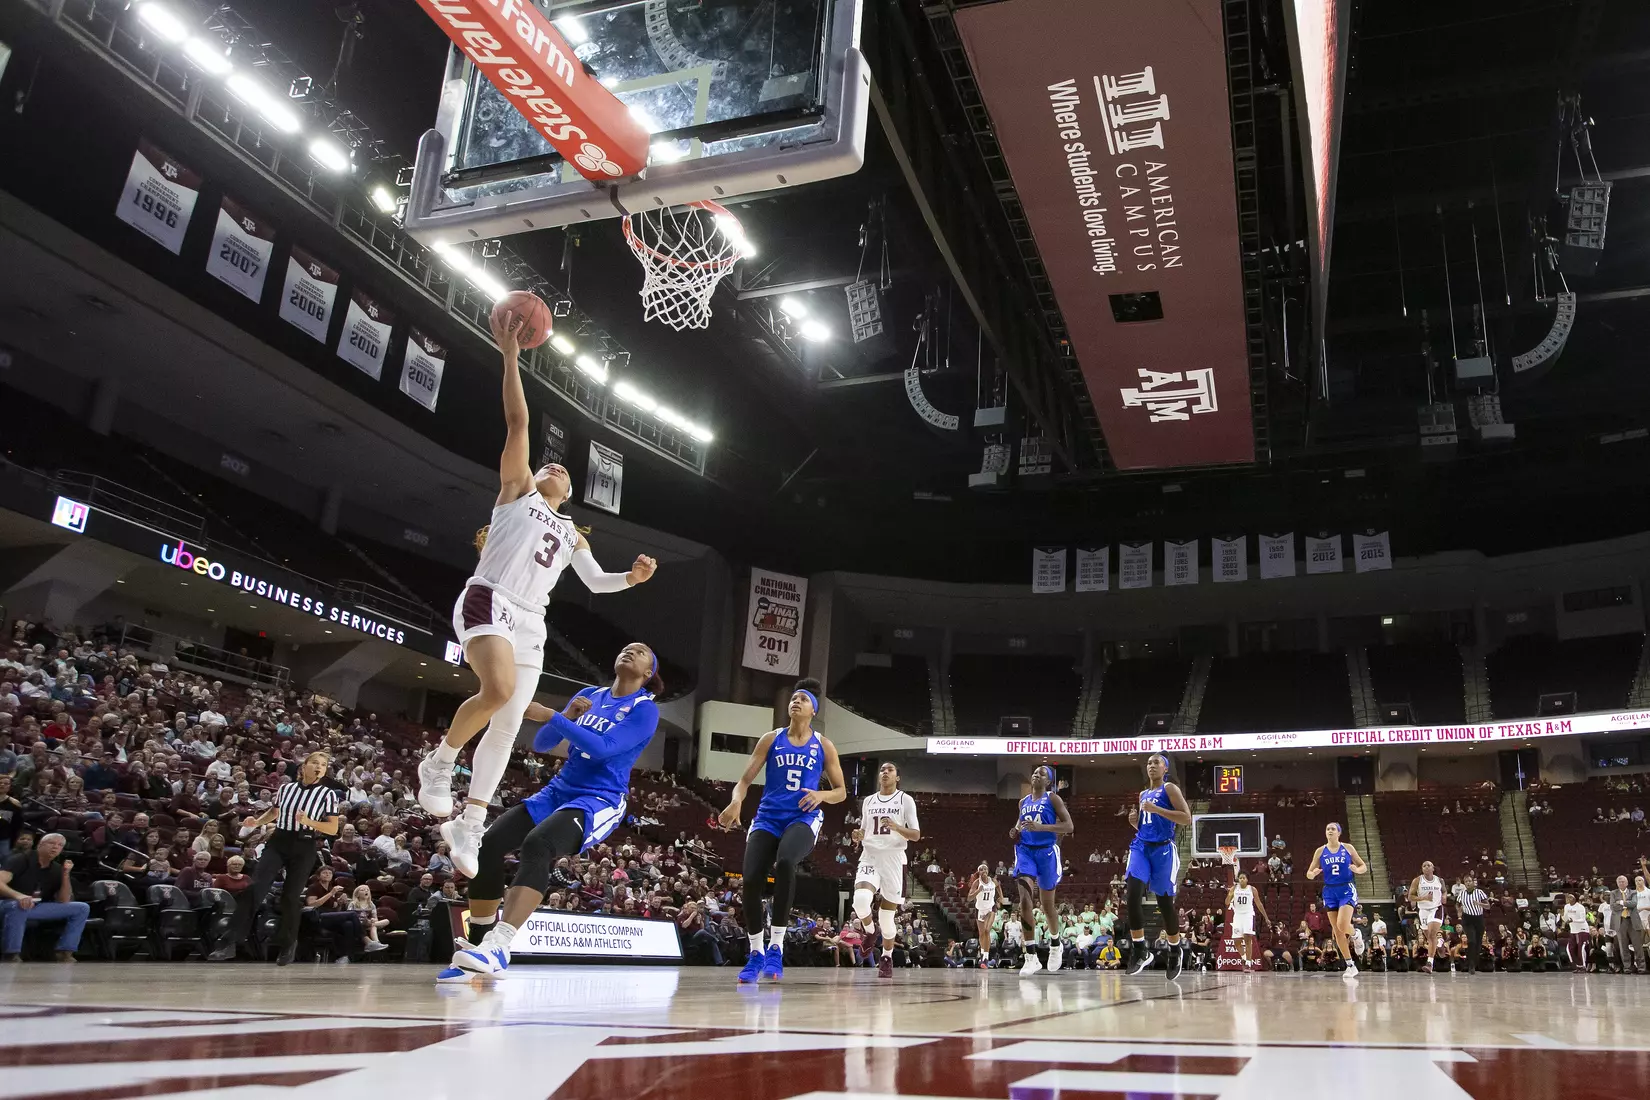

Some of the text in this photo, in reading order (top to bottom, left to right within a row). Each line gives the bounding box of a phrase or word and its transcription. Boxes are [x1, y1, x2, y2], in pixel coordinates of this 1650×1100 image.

[1047, 78, 1081, 140] Where
[1063, 142, 1102, 207] students
[140, 182, 182, 211] CHAMPIONSHIP
[133, 188, 179, 228] 1996
[1144, 160, 1183, 269] AMERICAN
[1082, 208, 1108, 237] love
[1115, 163, 1157, 272] CAMPUS
[220, 244, 260, 278] 2007
[290, 289, 326, 322] 2008
[350, 330, 379, 359] 2010
[408, 366, 435, 393] 2013
[549, 423, 564, 440] 2013
[544, 446, 564, 463] GARY
[528, 506, 562, 536] TEXAS
[534, 532, 561, 569] 3
[1312, 551, 1336, 561] 2012
[1360, 549, 1385, 560] 2015
[160, 541, 405, 645] ubeo BUSINESS SERVICES
[754, 585, 801, 602] CHAMPIONS
[760, 577, 797, 593] NATIONAL
[758, 635, 789, 653] 2011
[1256, 733, 1297, 741] AGGIELAND
[1332, 720, 1573, 743] OFFICIAL CREDIT UNION OF TEXAS A&M
[1006, 737, 1223, 753] OFFICIAL CREDIT UNION OF TEXAS A&M
[775, 753, 818, 771] DUKE
[785, 770, 802, 791] 5
[1222, 768, 1241, 777] 3:17
[1220, 776, 1238, 792] 27
[868, 807, 886, 815] TEXAS
[1021, 804, 1045, 815] DUKE
[1325, 856, 1346, 865] DUKE
[1331, 864, 1340, 875] 2
[982, 892, 990, 901] 11
[1237, 896, 1248, 904] 40
[526, 920, 644, 937] OFFICIAL LOGISTICS COMPANY
[529, 934, 632, 949] OF TEXAS A&M ATHLETICS
